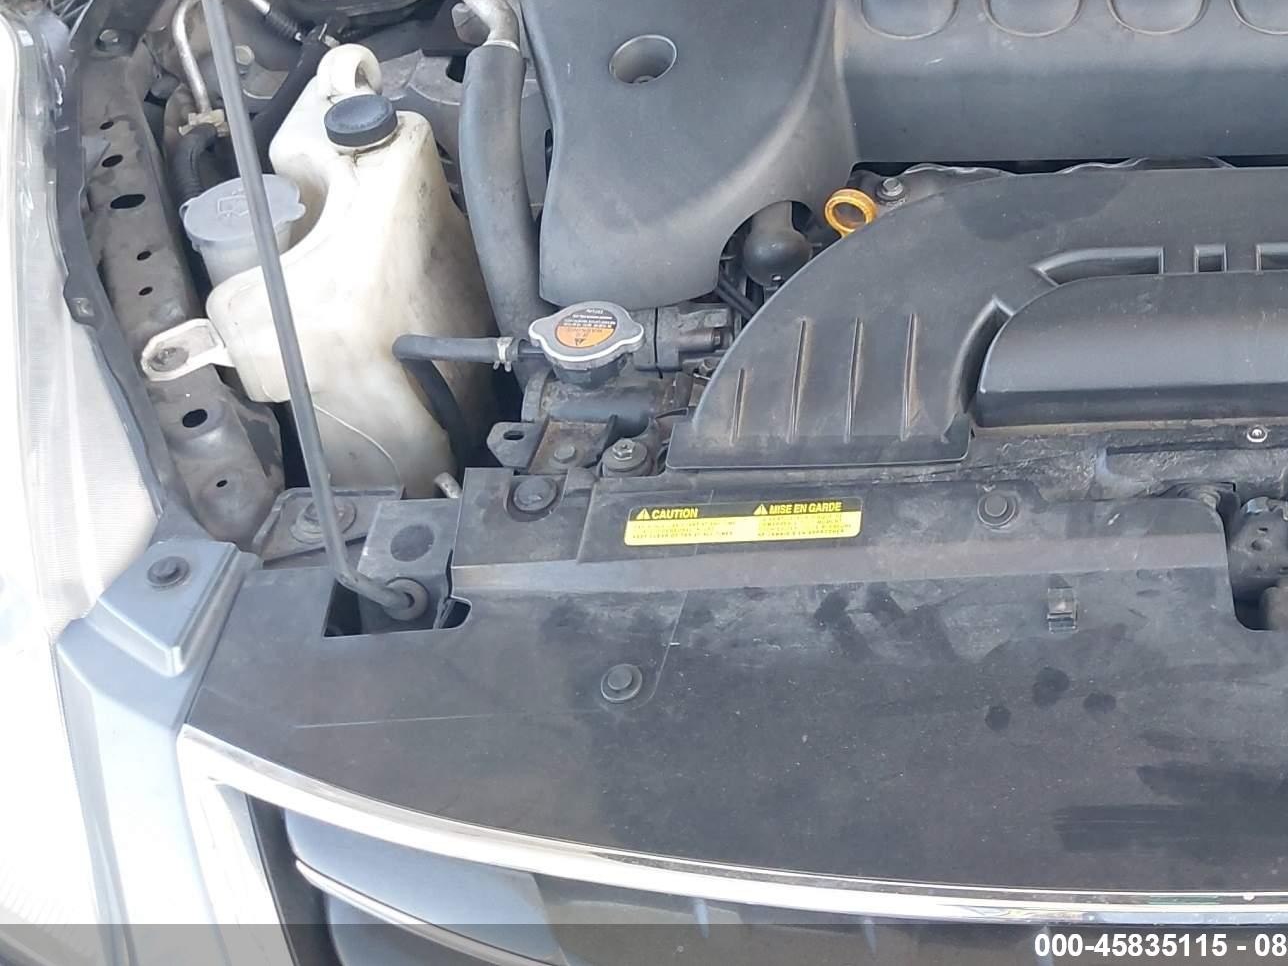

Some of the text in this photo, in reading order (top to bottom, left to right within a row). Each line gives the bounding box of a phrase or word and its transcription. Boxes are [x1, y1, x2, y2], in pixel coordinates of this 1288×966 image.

[651, 508, 698, 520] CAUTION
[769, 502, 842, 515] MISE EN GARDE
